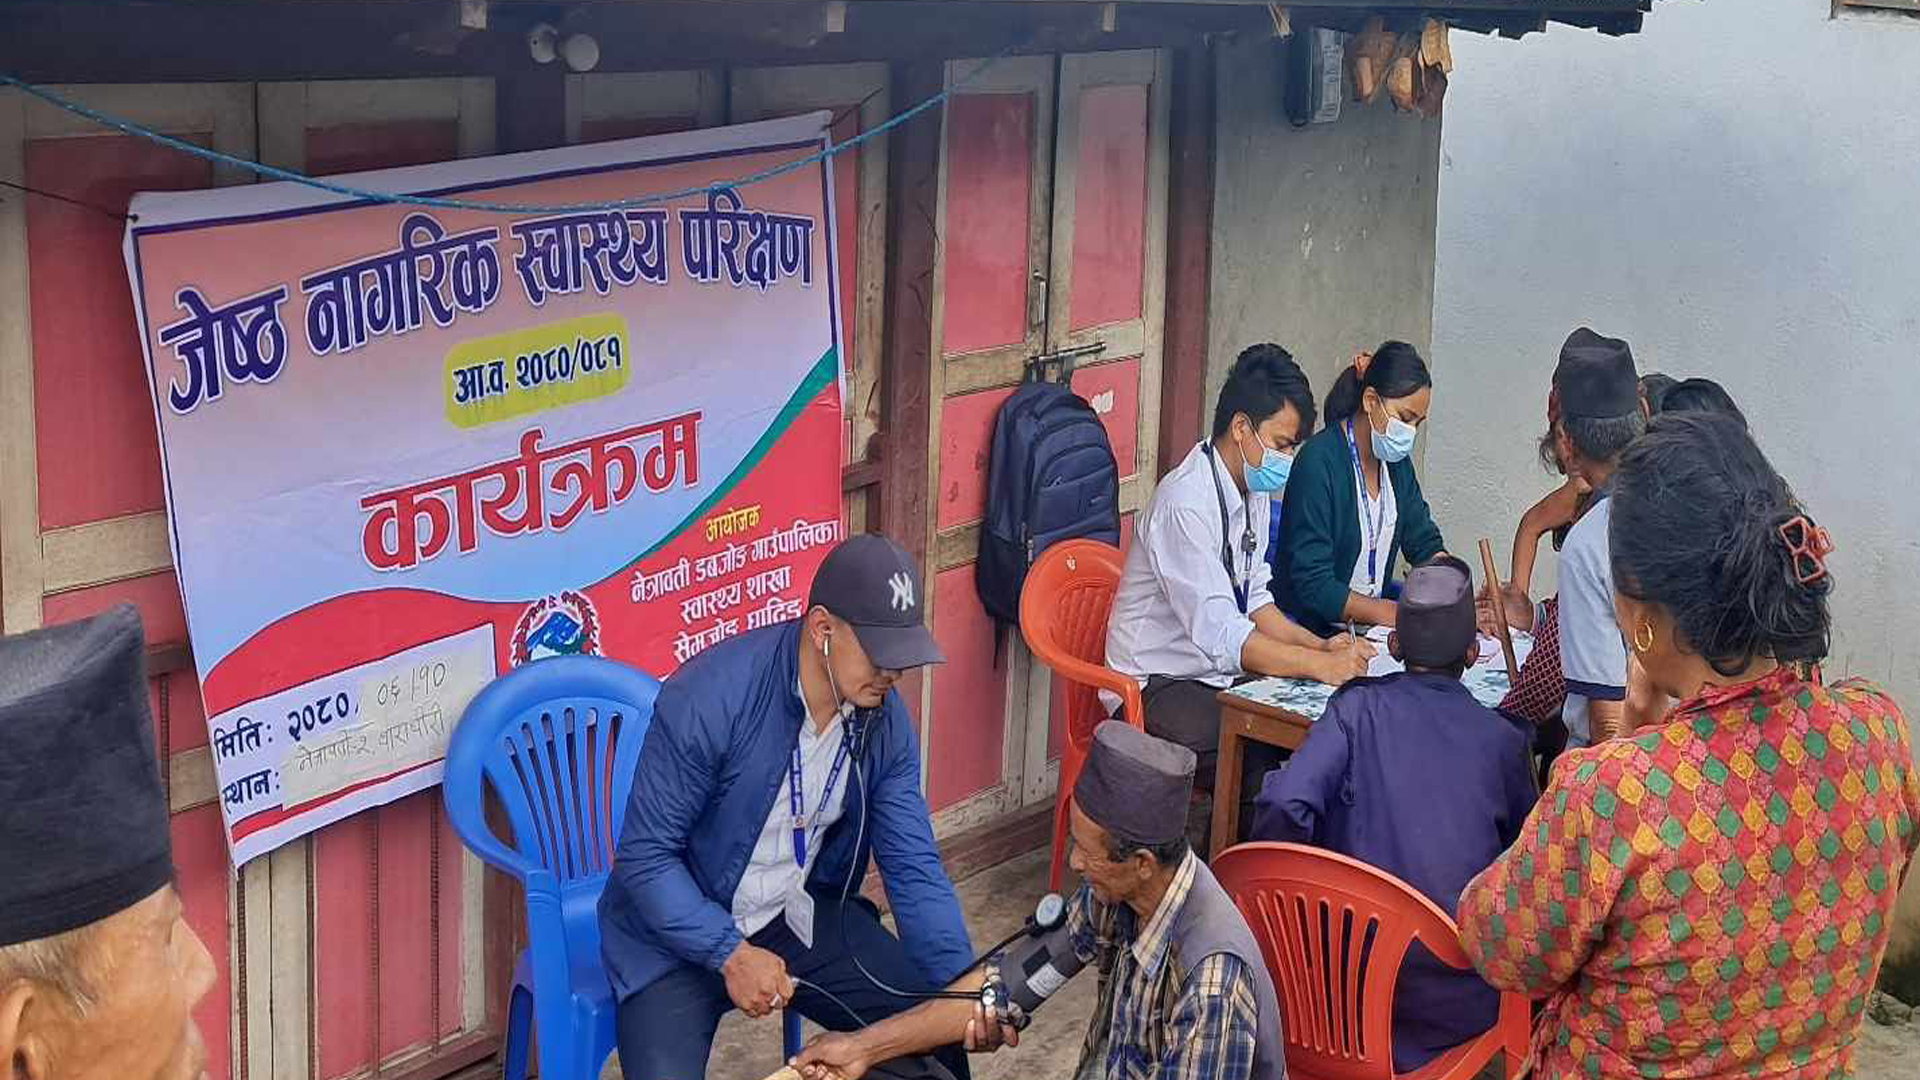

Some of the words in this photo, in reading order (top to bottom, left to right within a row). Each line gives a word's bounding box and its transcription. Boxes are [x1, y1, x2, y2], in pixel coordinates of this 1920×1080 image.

[158, 284, 290, 415] जेष्ठ
[300, 212, 500, 355] नागरिक
[510, 208, 668, 305] स्वास्थ्य
[678, 183, 814, 293] परिक्षण
[453, 361, 509, 403] आ.व.
[516, 336, 621, 386] २०८०/०८१
[360, 410, 702, 572] कार्यक्रम
[706, 505, 761, 540] आयोजक
[631, 559, 690, 602] नेत्रावती
[695, 543, 748, 582] डबजोङ
[680, 582, 742, 624] स्वास्थ्य
[746, 565, 791, 600] शाखा
